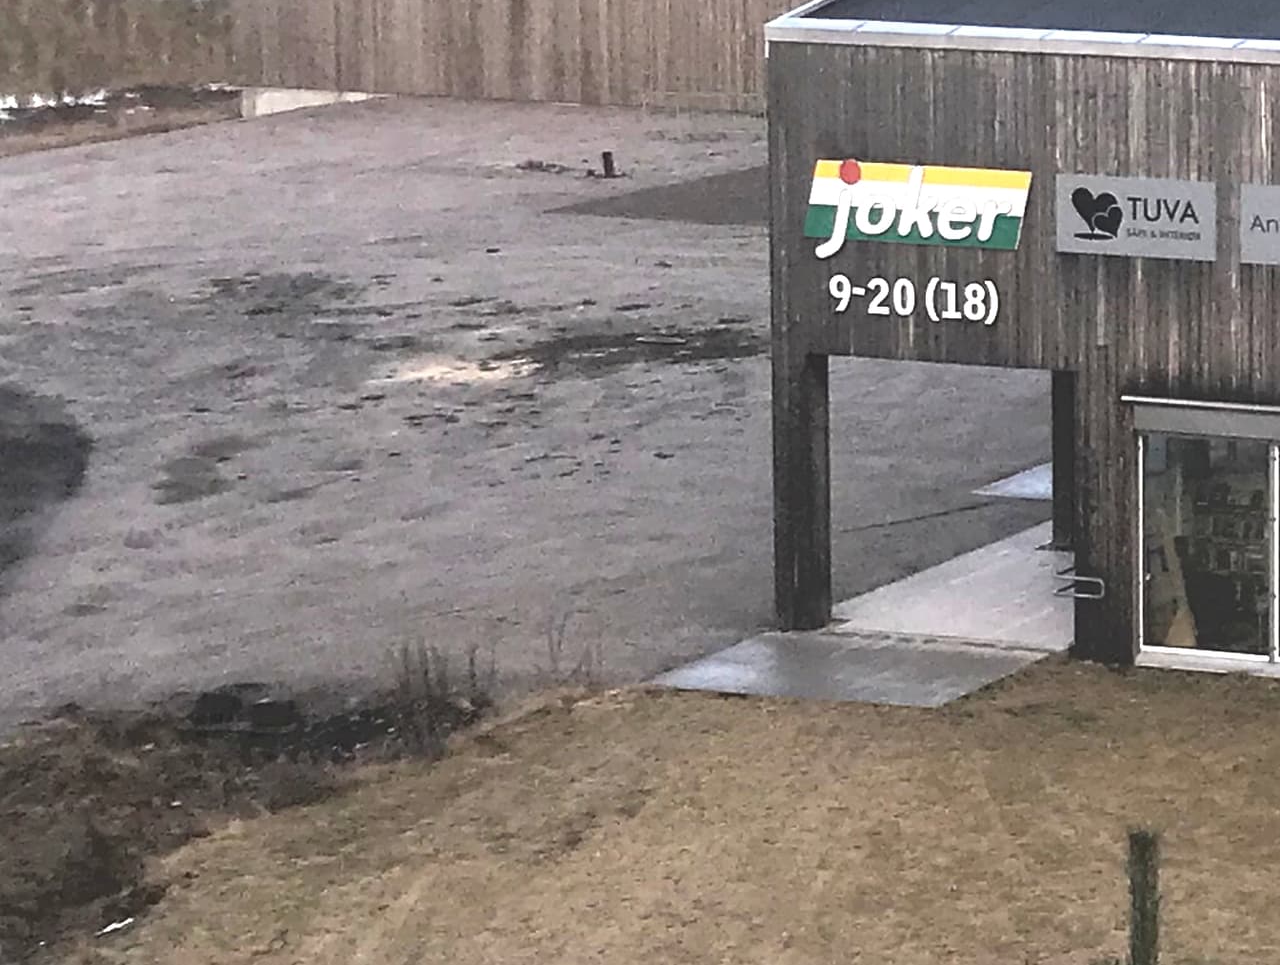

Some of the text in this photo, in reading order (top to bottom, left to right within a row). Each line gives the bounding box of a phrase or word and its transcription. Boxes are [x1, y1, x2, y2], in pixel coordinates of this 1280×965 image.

[815, 159, 1013, 258] joker
[1127, 197, 1199, 224] TUVA
[829, 274, 998, 325] 9-20 (18)
